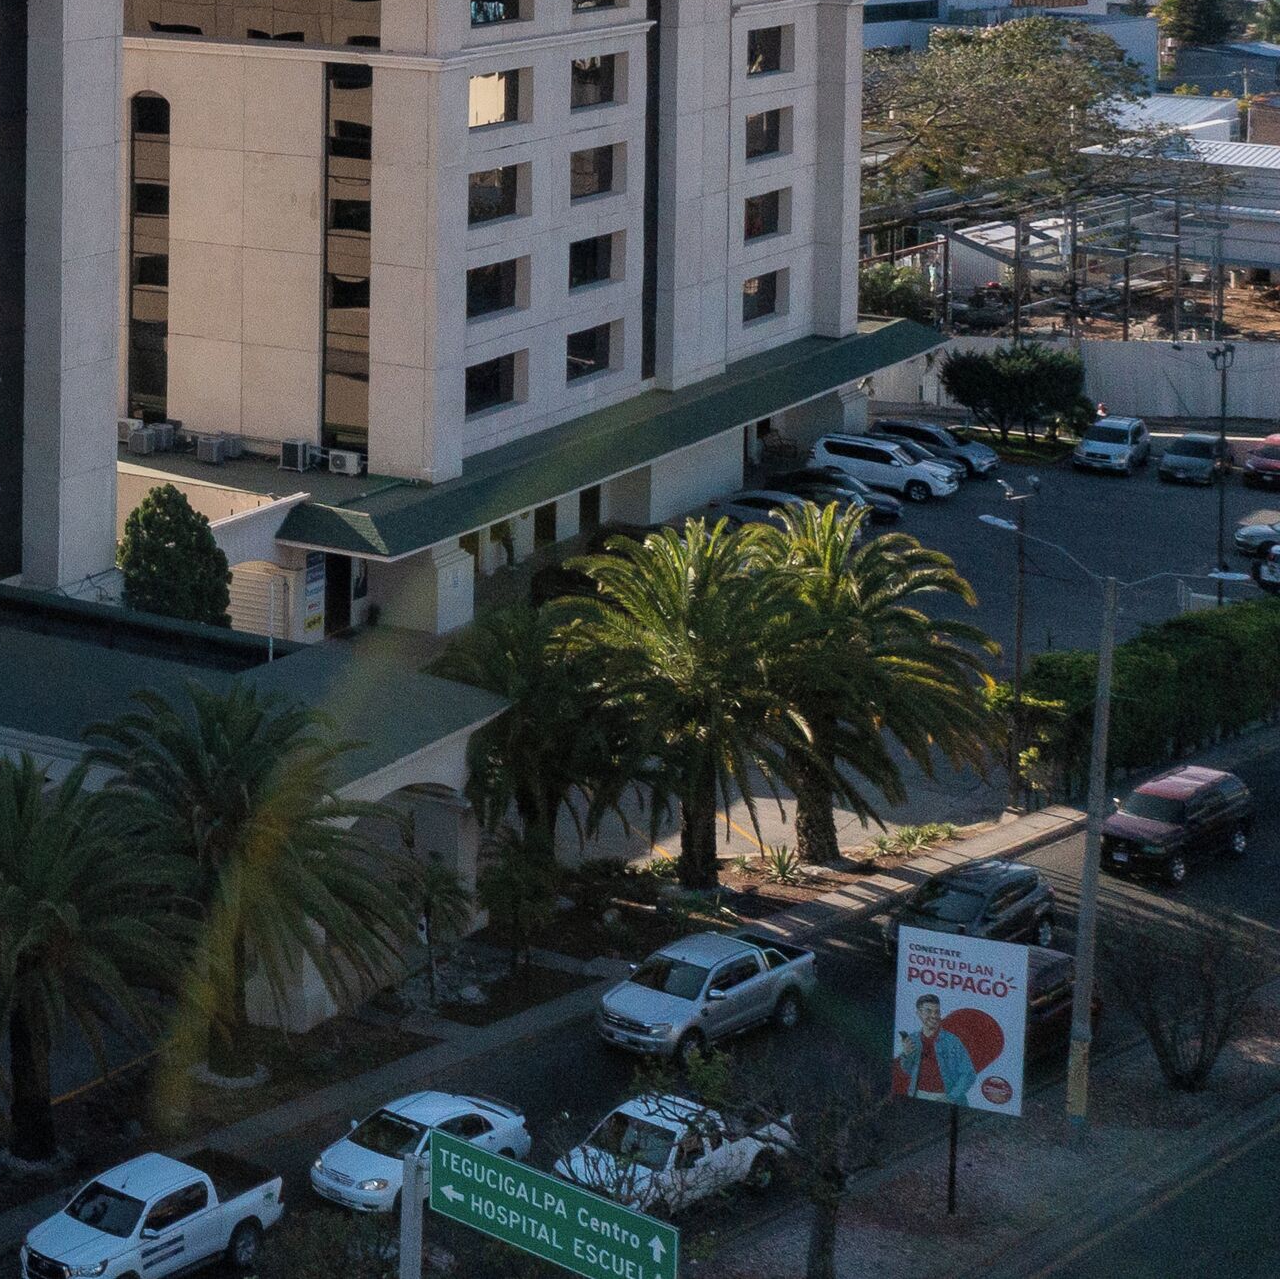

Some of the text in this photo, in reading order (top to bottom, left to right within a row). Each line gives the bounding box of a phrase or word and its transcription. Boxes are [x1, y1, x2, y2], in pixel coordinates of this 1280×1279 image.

[907, 967, 1009, 998] POSPAGO
[909, 953, 994, 977] CON TU PLAN
[439, 1148, 640, 1249] TEGUCIGALPA Centro
[470, 1193, 564, 1251] HOSPITAL
